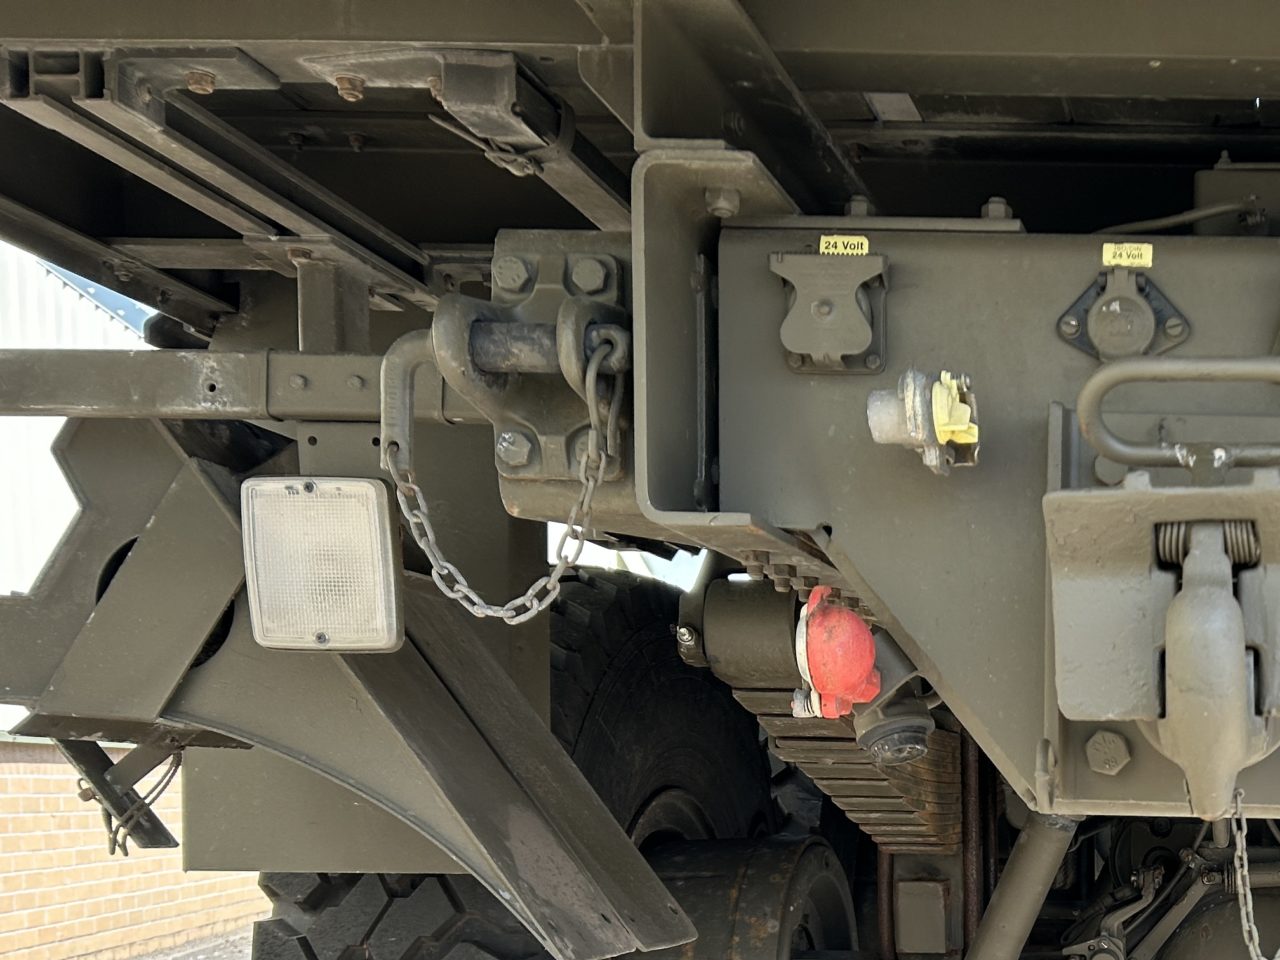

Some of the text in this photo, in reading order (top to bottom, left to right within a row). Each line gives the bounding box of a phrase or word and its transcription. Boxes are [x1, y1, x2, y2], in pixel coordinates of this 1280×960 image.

[824, 240, 864, 250] 24 Volt
[1112, 251, 1143, 260] 24 Volt
